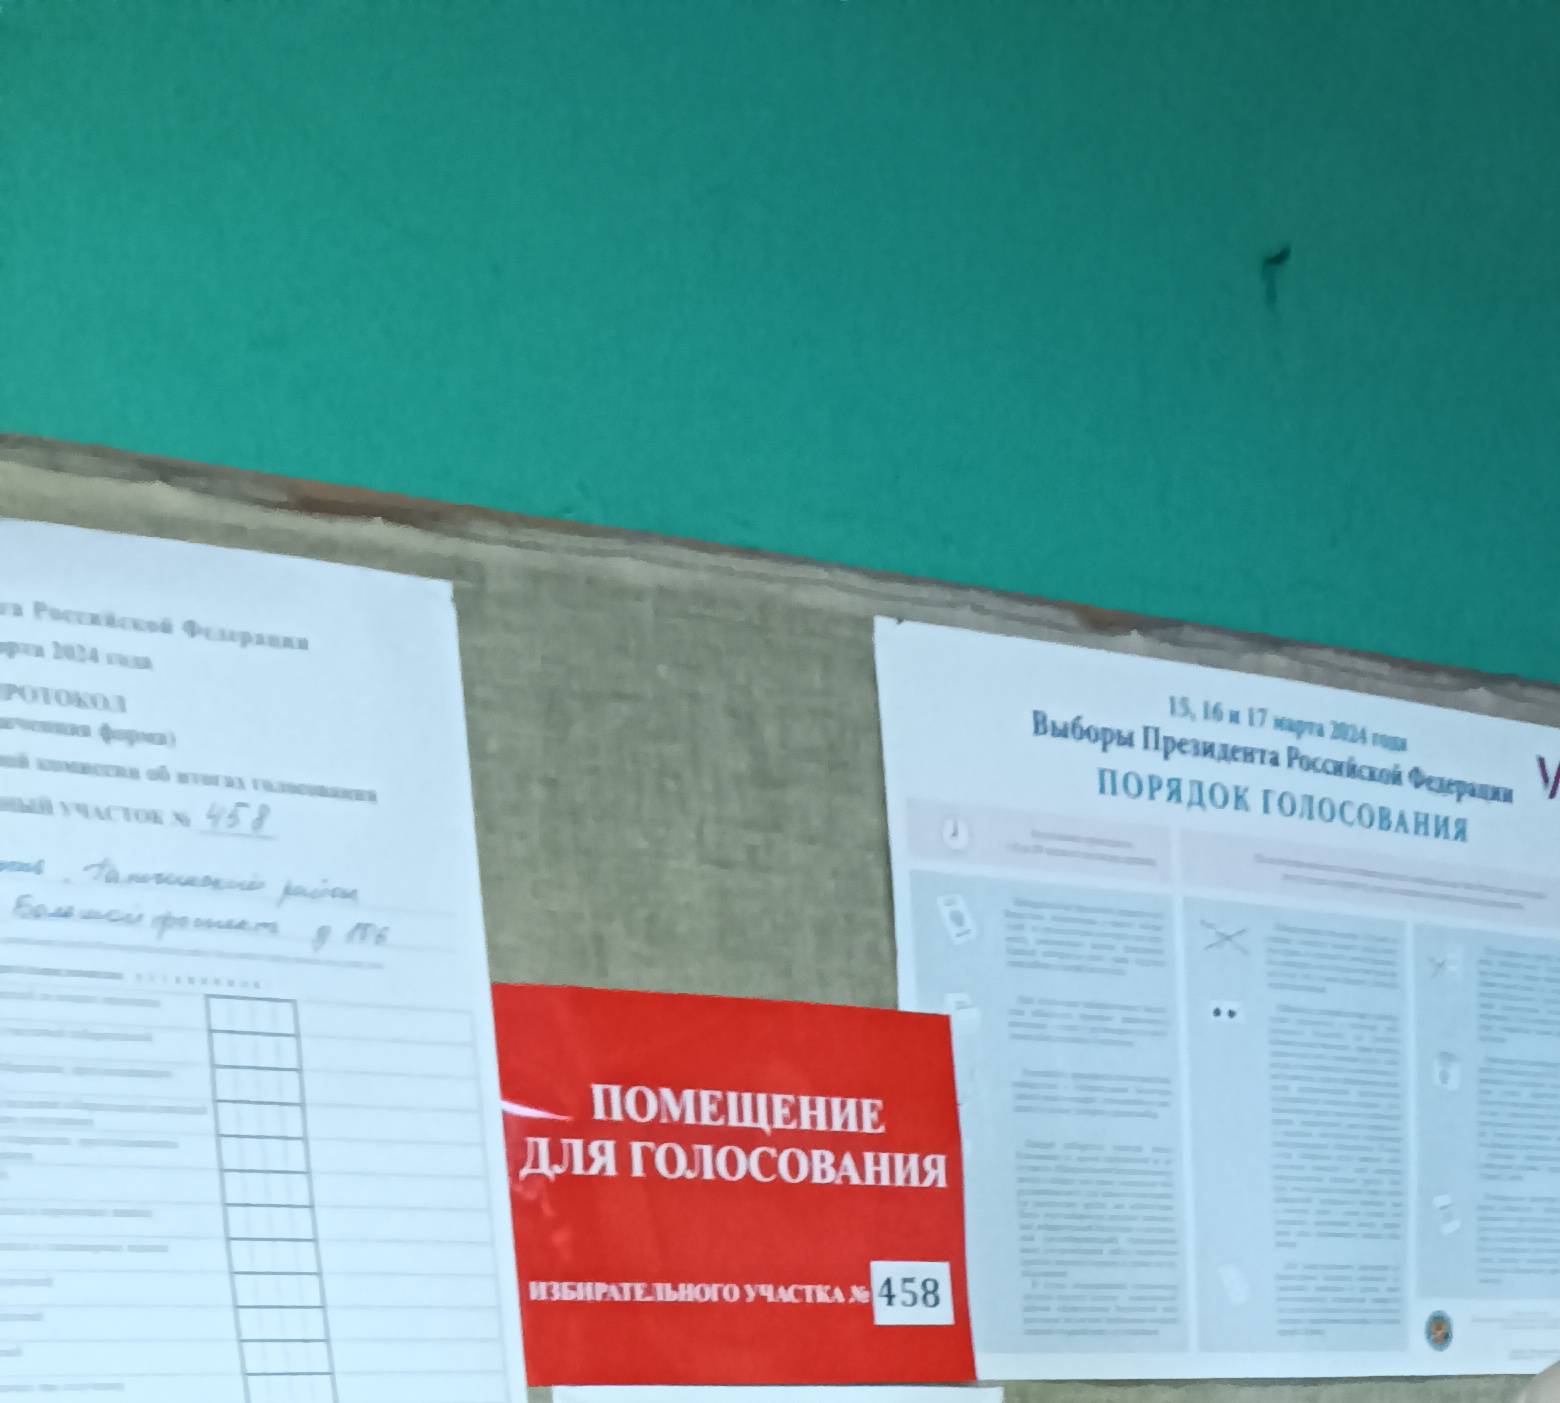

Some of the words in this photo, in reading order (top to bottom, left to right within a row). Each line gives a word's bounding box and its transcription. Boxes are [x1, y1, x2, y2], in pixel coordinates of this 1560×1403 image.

[33, 601, 173, 634] Российской
[182, 619, 309, 650] Федерации
[0, 683, 126, 713] РОТОКОЛ
[1169, 695, 1197, 722] 15,
[1203, 700, 1223, 723] 16
[1248, 706, 1268, 728] 17
[1273, 715, 1325, 739] марта
[1330, 720, 1367, 743] 2024
[1372, 732, 1408, 752] года
[1032, 709, 1135, 752] Выборы
[1143, 725, 1280, 761] Президента
[1287, 745, 1403, 786] Российской
[1407, 766, 1513, 804] Федерации
[206, 801, 271, 832] 458
[1098, 767, 1250, 813] ПОРЯДОК
[1262, 789, 1468, 843] ГОЛОСОВАНИЯ
[590, 1083, 886, 1135] ПОМЕЩЕНИЕ
[519, 1136, 618, 1181] ДЛЯ
[629, 1140, 948, 1188] ГОЛОСОВАНИЯ
[528, 1280, 740, 1304] ИЗБИРАТЕЛЬНОГО
[744, 1282, 845, 1304] УЧАСТКА
[877, 1276, 941, 1309] 458
